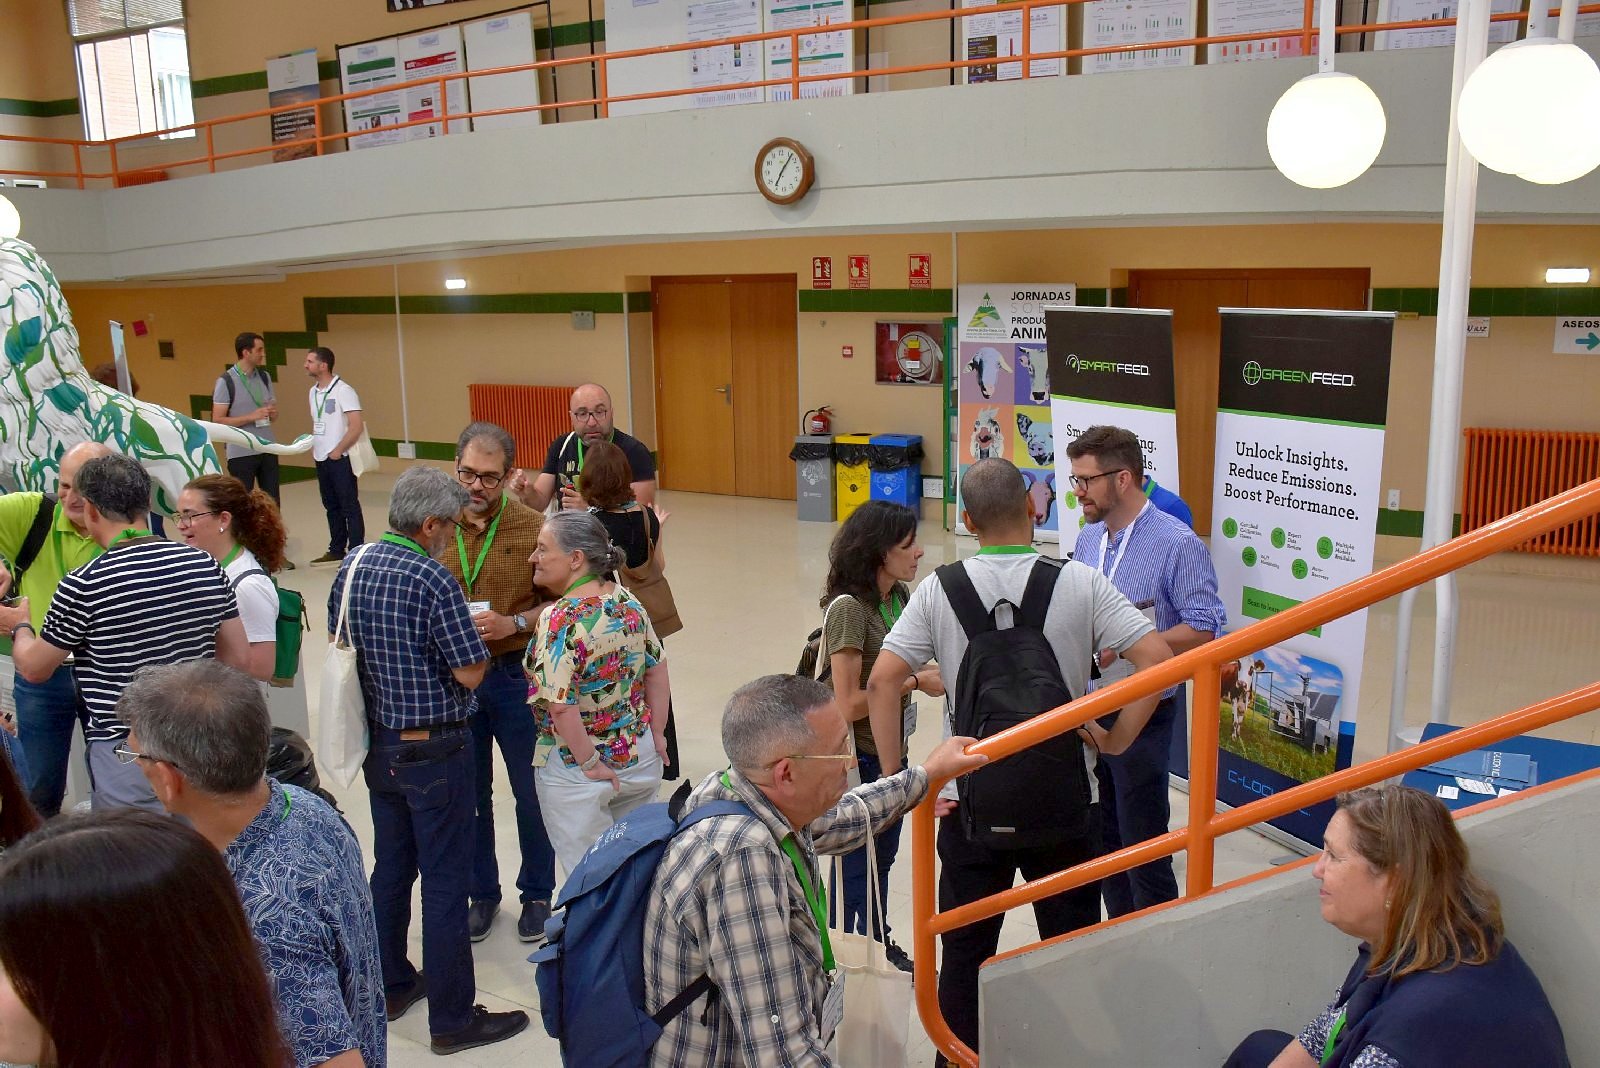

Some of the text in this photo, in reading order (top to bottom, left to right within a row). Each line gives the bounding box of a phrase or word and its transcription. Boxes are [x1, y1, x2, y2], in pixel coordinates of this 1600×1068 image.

[1011, 291, 1071, 301] JORNADAS
[1011, 316, 1046, 325] PRODUC
[1562, 320, 1600, 328] ASEOS
[1010, 327, 1047, 339] ANIM
[1079, 360, 1149, 376] SMARTFEED
[1261, 368, 1354, 387] GREENFEED
[1236, 441, 1348, 471] Unlock Insights.
[1228, 462, 1357, 497] Reduce Emissions.
[1224, 483, 1359, 521] Boost Performance.
[1228, 769, 1275, 797] C-LOC
